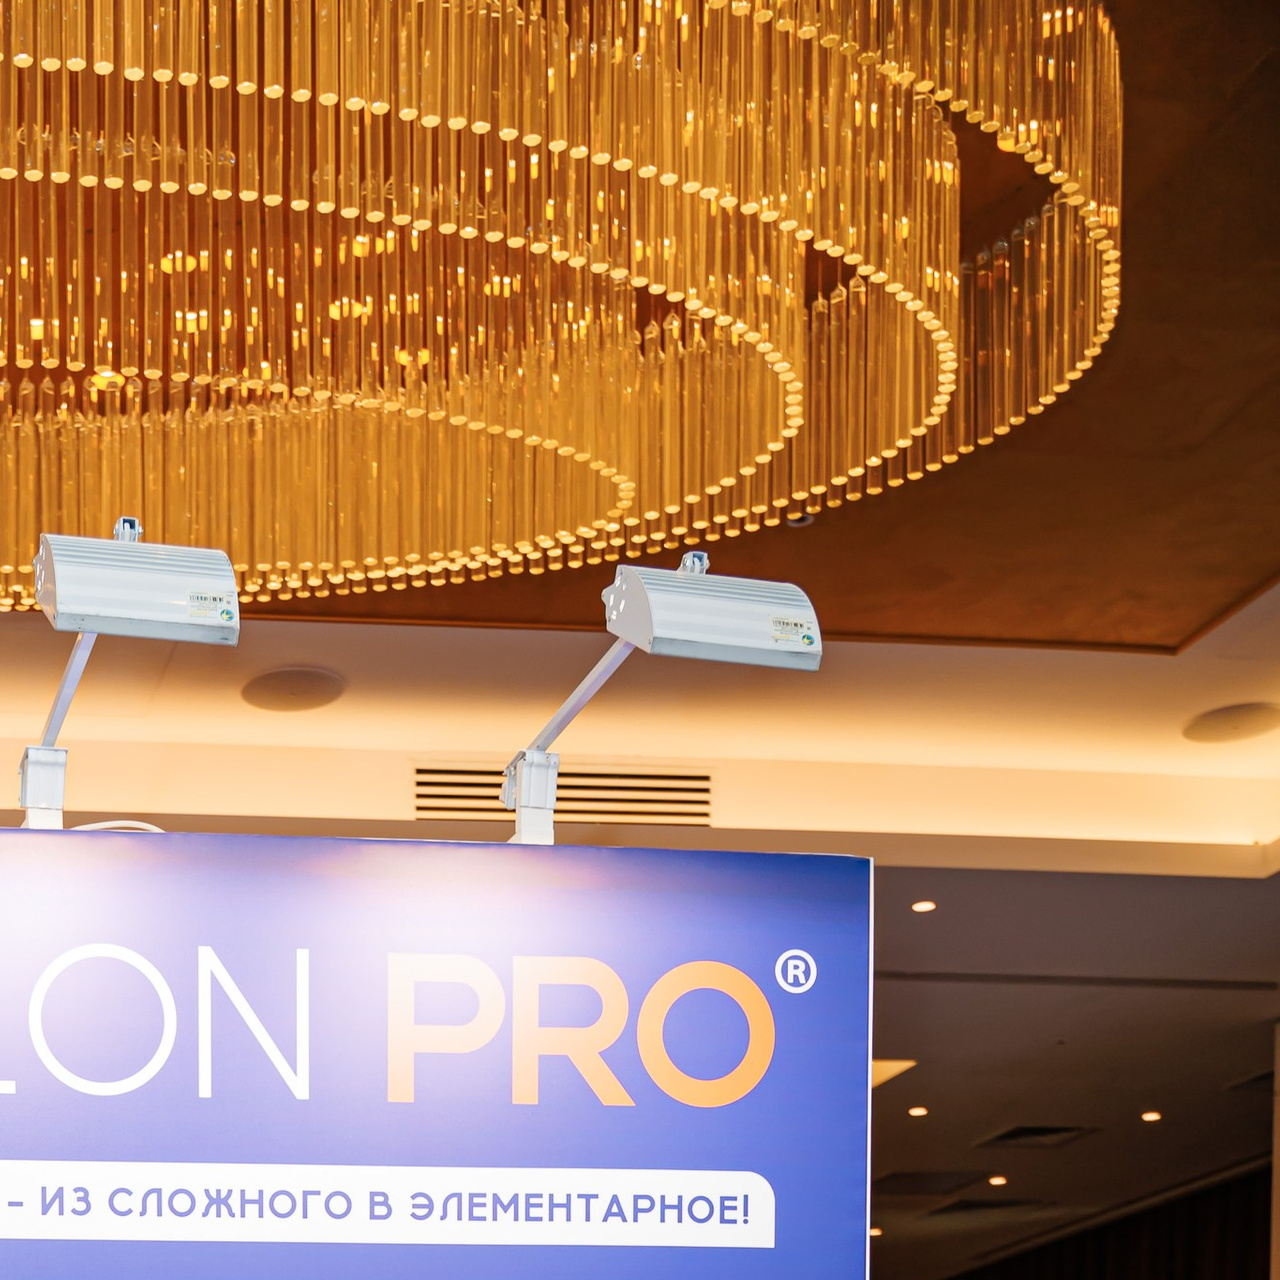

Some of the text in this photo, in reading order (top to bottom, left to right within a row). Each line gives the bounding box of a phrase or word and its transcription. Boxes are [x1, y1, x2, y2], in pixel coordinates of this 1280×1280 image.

[38, 1186, 93, 1218] ИЗ
[107, 1187, 353, 1221] СЛОЖНОГО
[369, 1190, 394, 1221] В
[409, 1191, 752, 1226] ЭЛЕМЕНТАРНОЕ!
